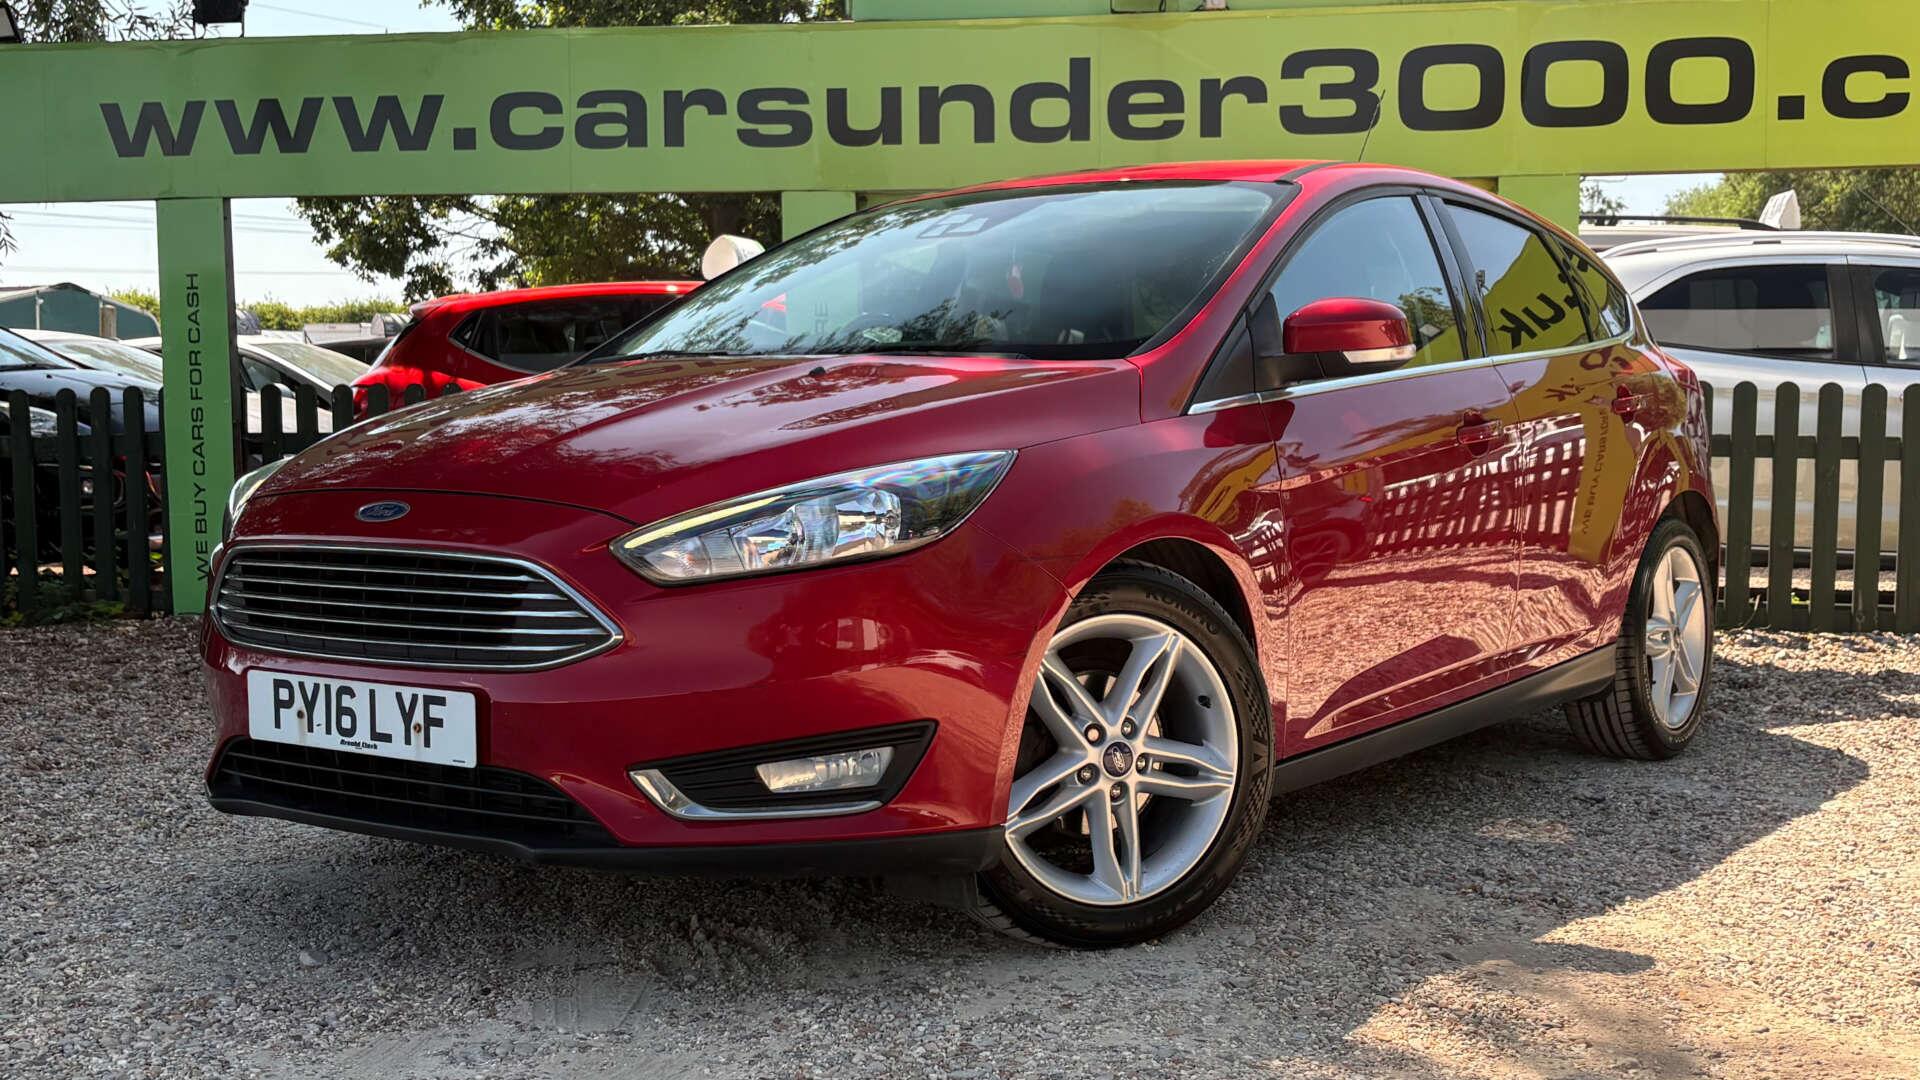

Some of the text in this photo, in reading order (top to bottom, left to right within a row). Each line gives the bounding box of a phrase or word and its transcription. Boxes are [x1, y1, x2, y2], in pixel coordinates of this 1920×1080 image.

[99, 37, 1910, 158] www.carsunder3000.c
[186, 273, 210, 581] WE BUY CARS FOR CASH
[273, 679, 447, 748] PY16 LYF
